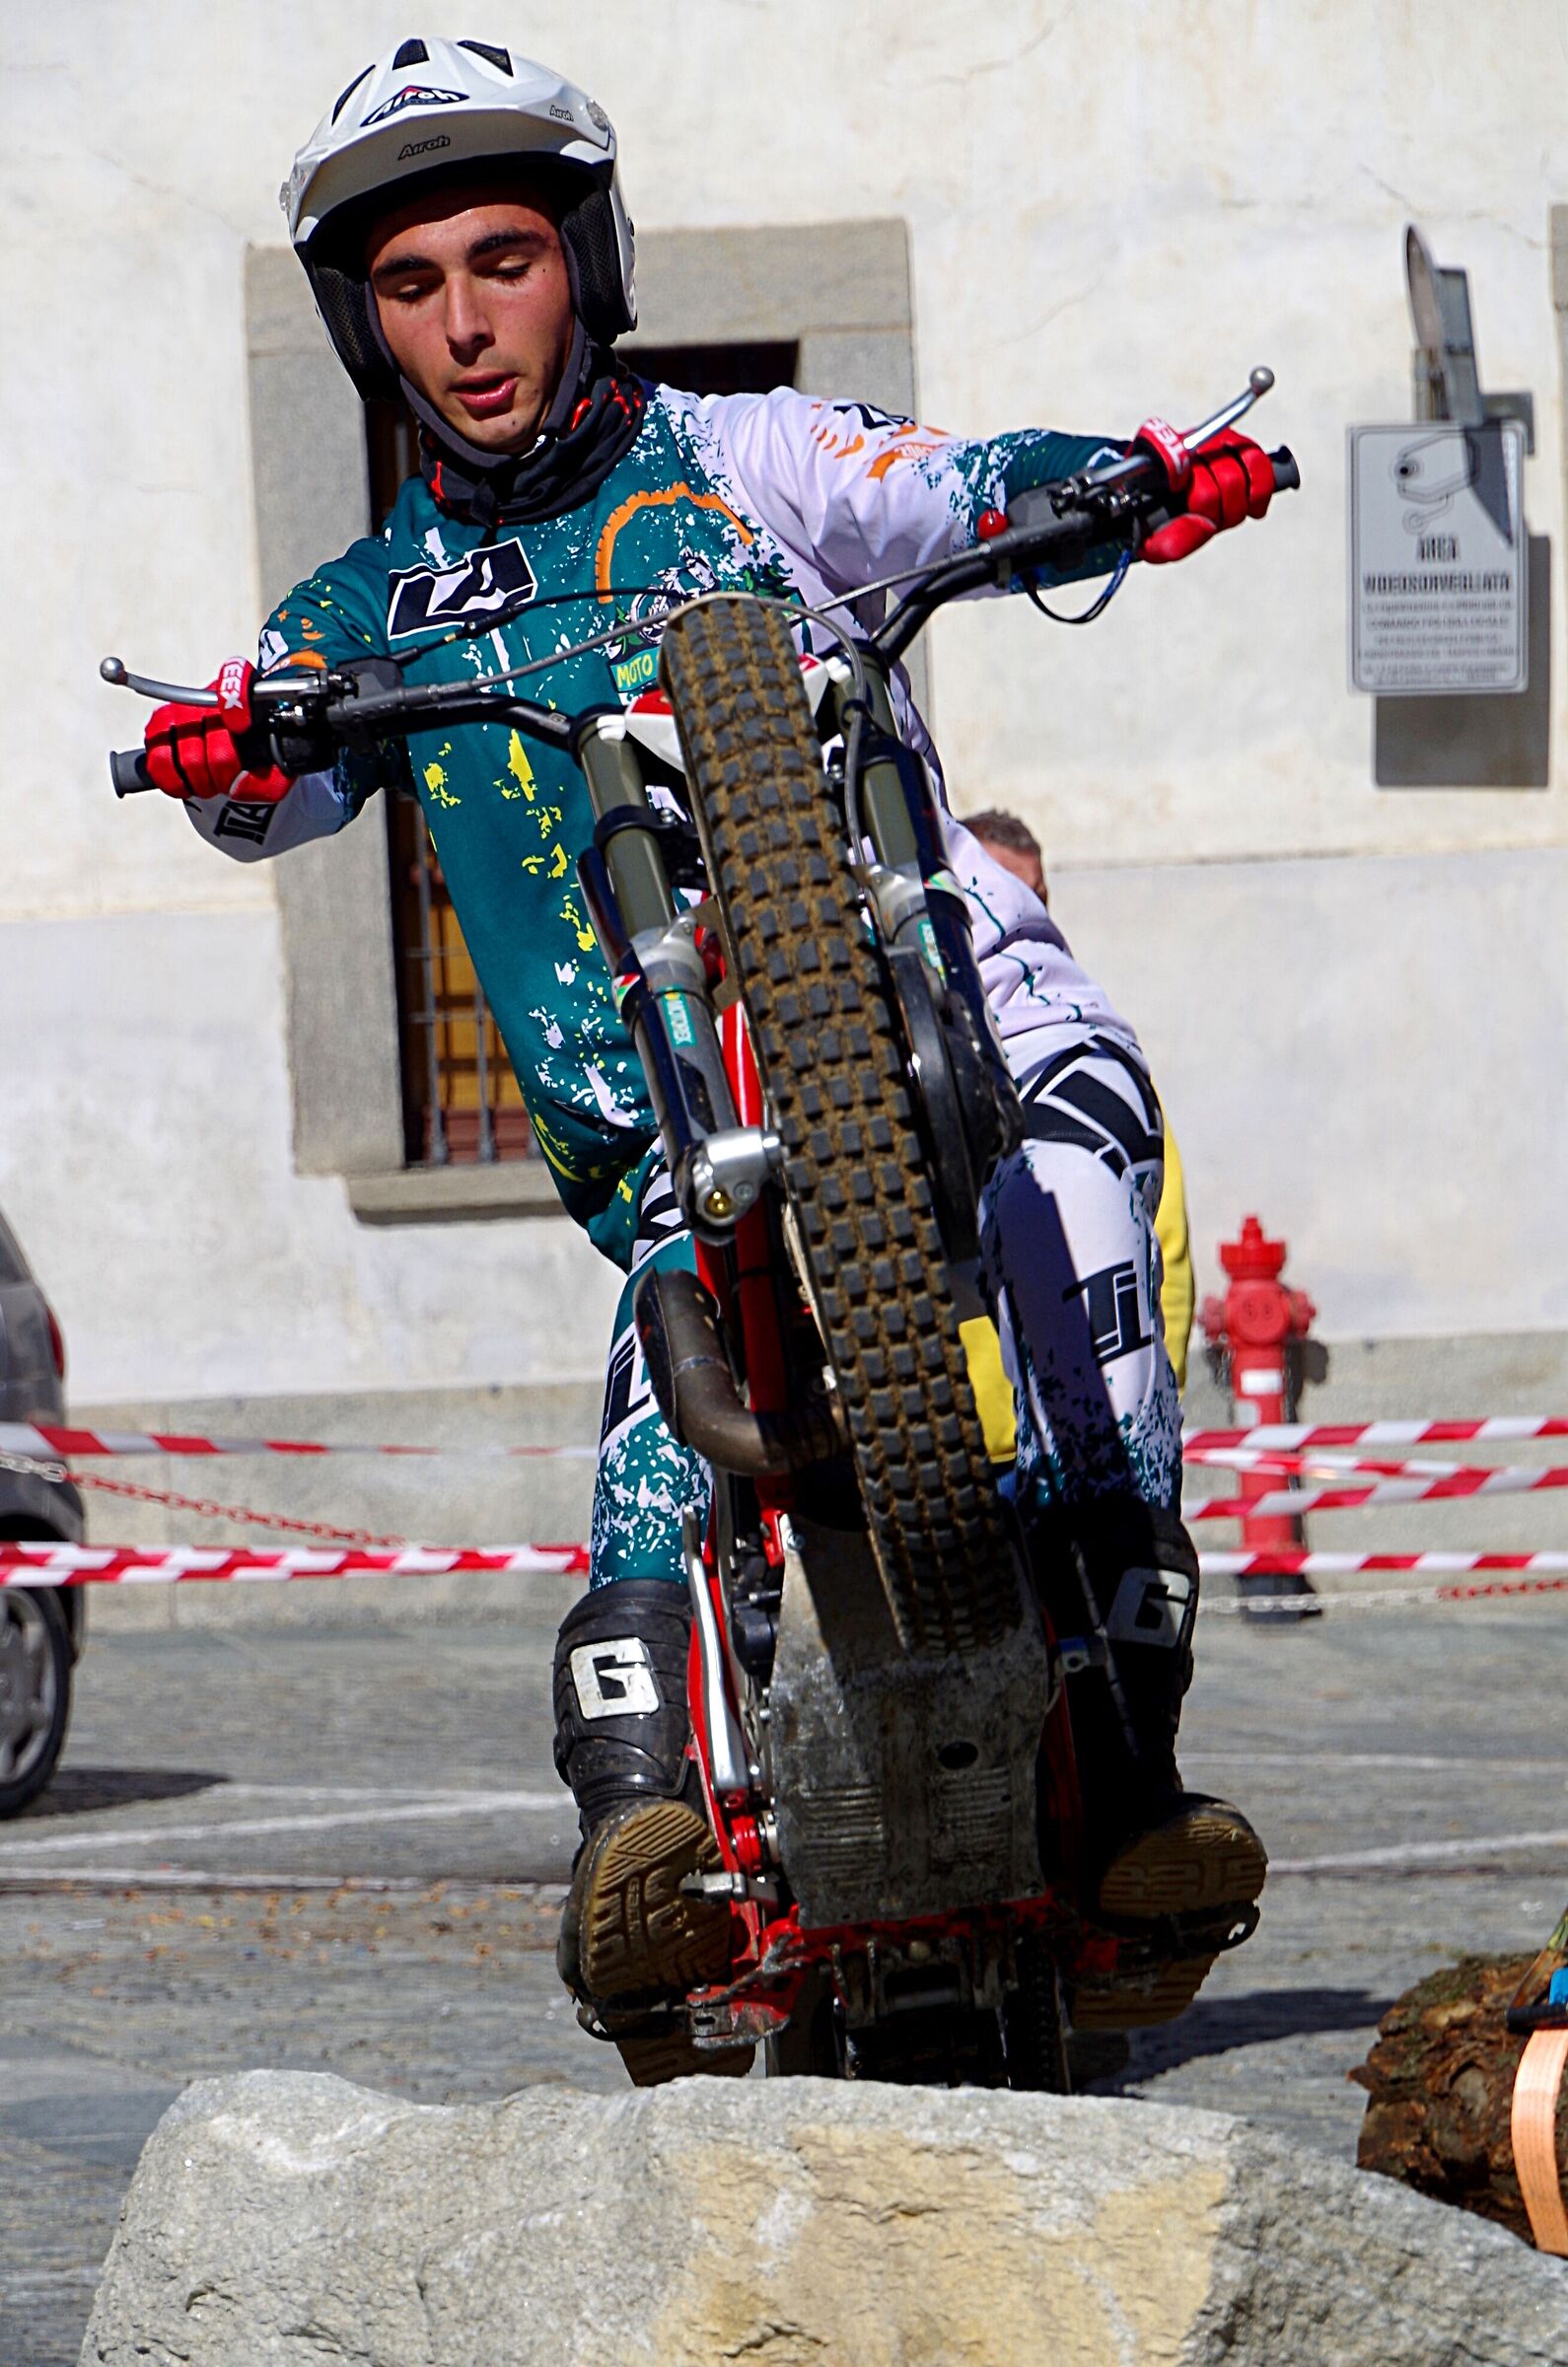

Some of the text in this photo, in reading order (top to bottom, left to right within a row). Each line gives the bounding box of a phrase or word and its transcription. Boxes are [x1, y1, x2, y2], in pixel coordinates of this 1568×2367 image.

[367, 88, 461, 124] Airoh
[397, 134, 451, 161] Airoh
[615, 653, 654, 688] MOTO
[569, 1636, 660, 1720] G
